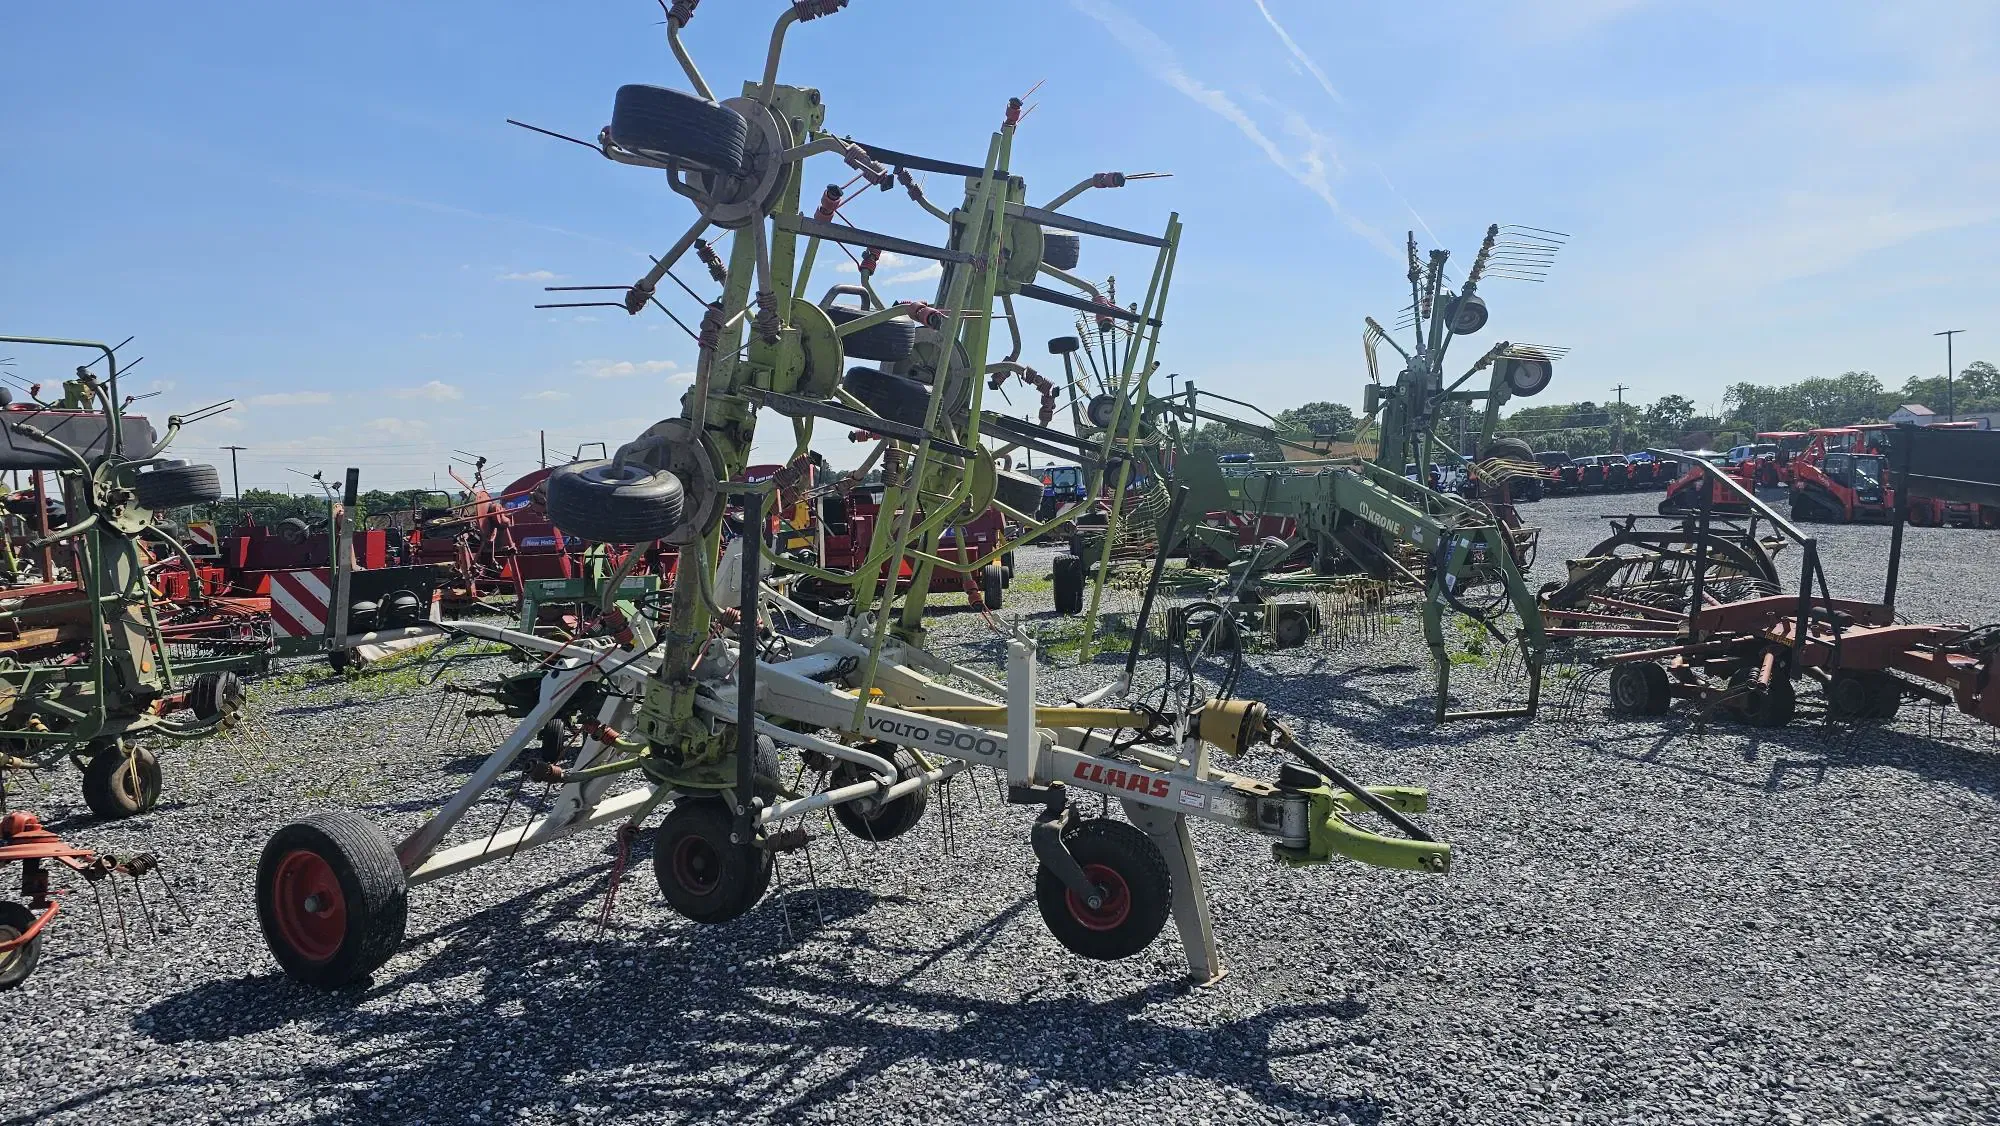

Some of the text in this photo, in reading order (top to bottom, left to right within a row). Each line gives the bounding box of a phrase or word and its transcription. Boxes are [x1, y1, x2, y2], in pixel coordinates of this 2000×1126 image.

[1368, 509, 1401, 535] KRONE
[868, 716, 930, 741] VOLTO
[1073, 761, 1172, 798] CLAAS
